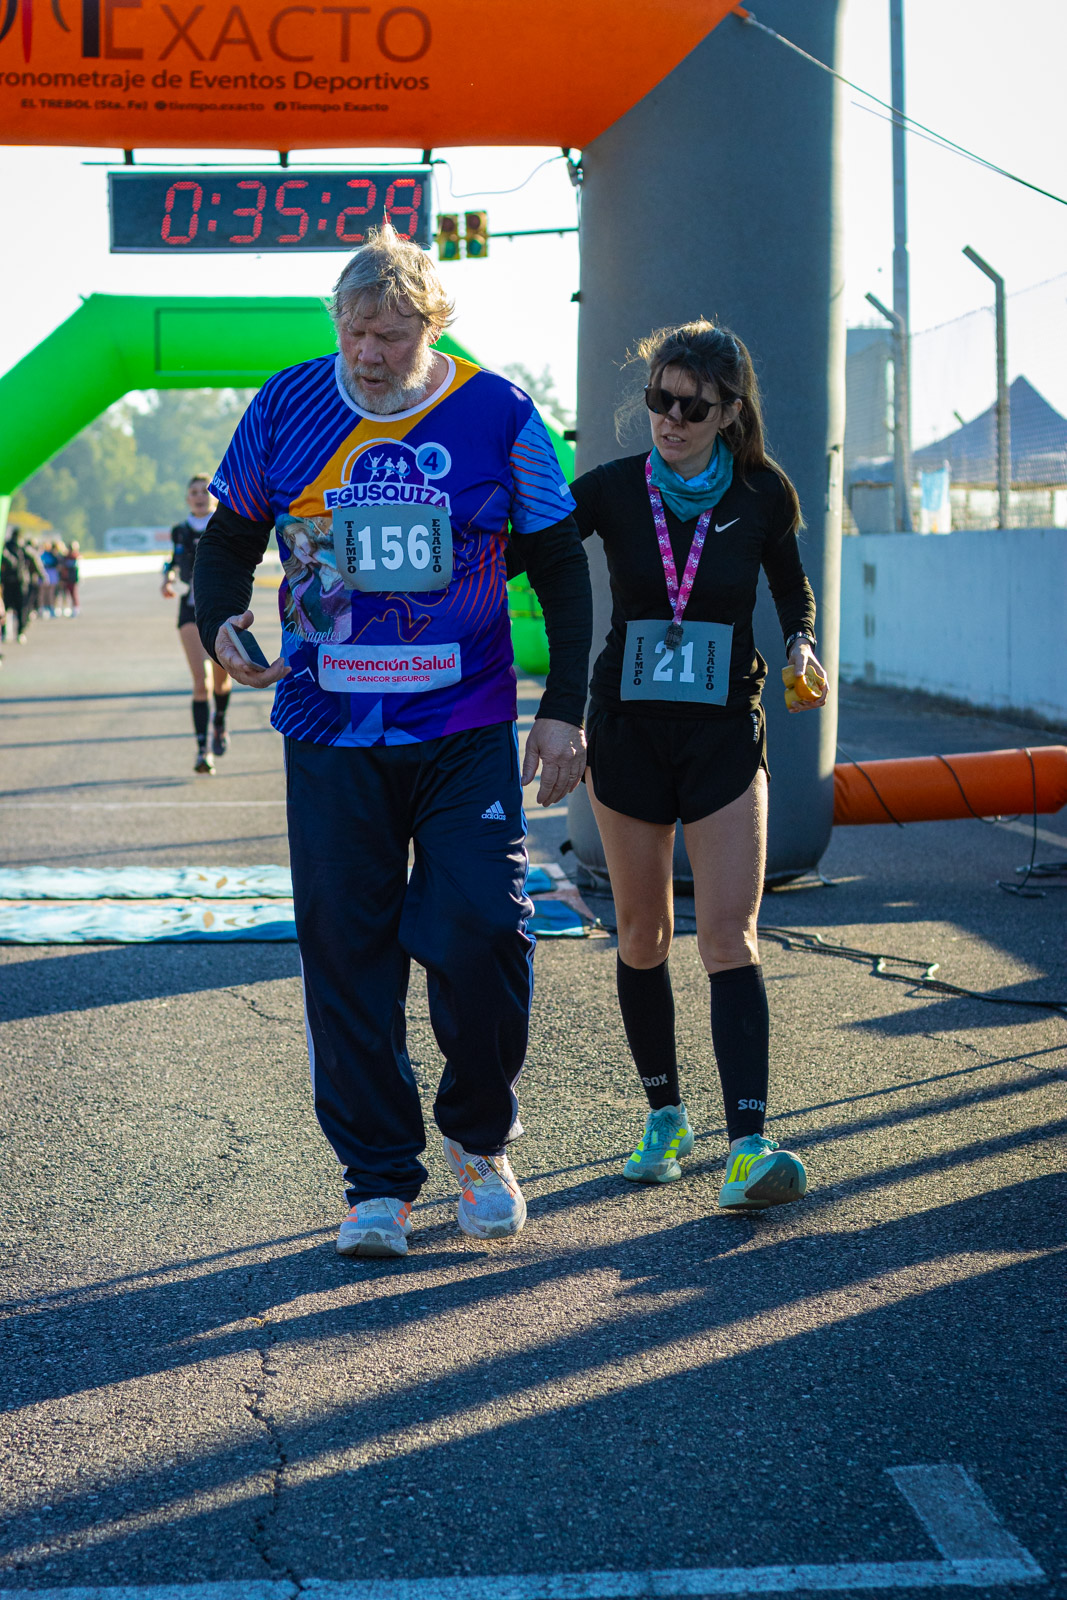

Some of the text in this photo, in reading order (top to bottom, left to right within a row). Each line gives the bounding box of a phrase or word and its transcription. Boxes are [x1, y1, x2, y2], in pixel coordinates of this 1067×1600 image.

[152, 69, 182, 88] de
[190, 70, 286, 89] Eventos
[293, 71, 430, 94] Deportivos
[21, 98, 36, 108] EL
[289, 102, 341, 112] Tiempo
[344, 102, 389, 112] Exacto
[423, 451, 438, 471] 4
[325, 483, 447, 509] EGUSQUIZA
[344, 520, 357, 574] TIEMPO
[357, 524, 431, 571] 156
[431, 518, 442, 573] EXACTO
[322, 653, 456, 671] Prevención Salud
[633, 636, 644, 686] TIEMPO
[652, 640, 695, 683] 21
[705, 640, 716, 691] EXACTO
[356, 675, 390, 683] SANCOR
[391, 675, 430, 683] SEGUROS
[642, 1073, 669, 1087] SOX
[737, 1099, 766, 1112] SOX
